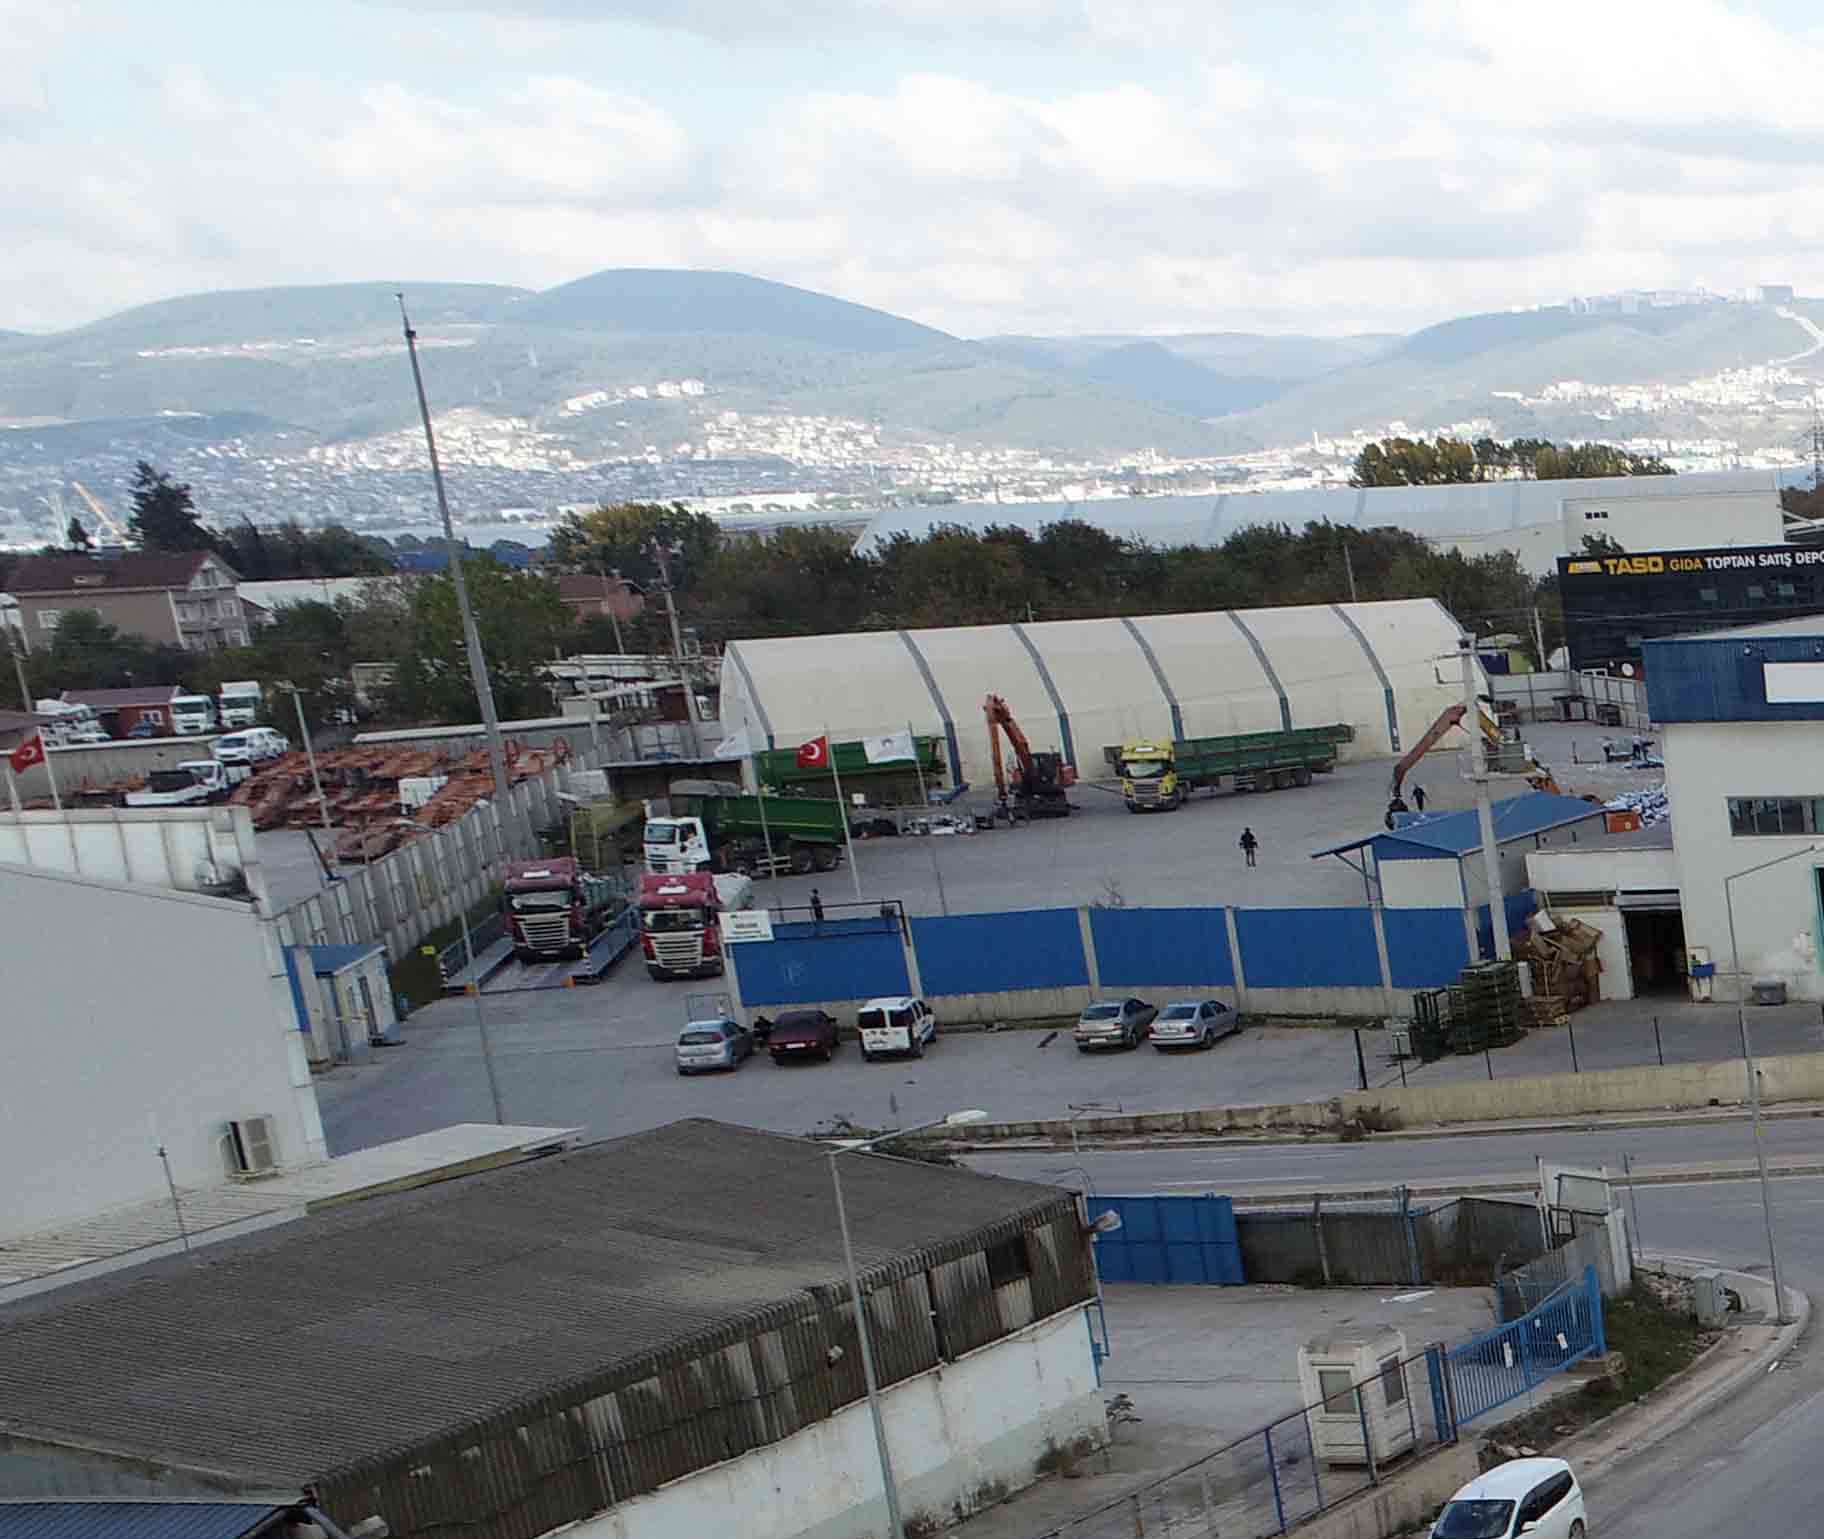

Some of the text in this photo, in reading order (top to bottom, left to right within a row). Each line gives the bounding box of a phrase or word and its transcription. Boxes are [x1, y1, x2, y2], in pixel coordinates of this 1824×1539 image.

[1669, 557, 1703, 571] GIDA
[1705, 554, 1756, 570] TOPTAN
[1759, 552, 1792, 567] SATIŞ
